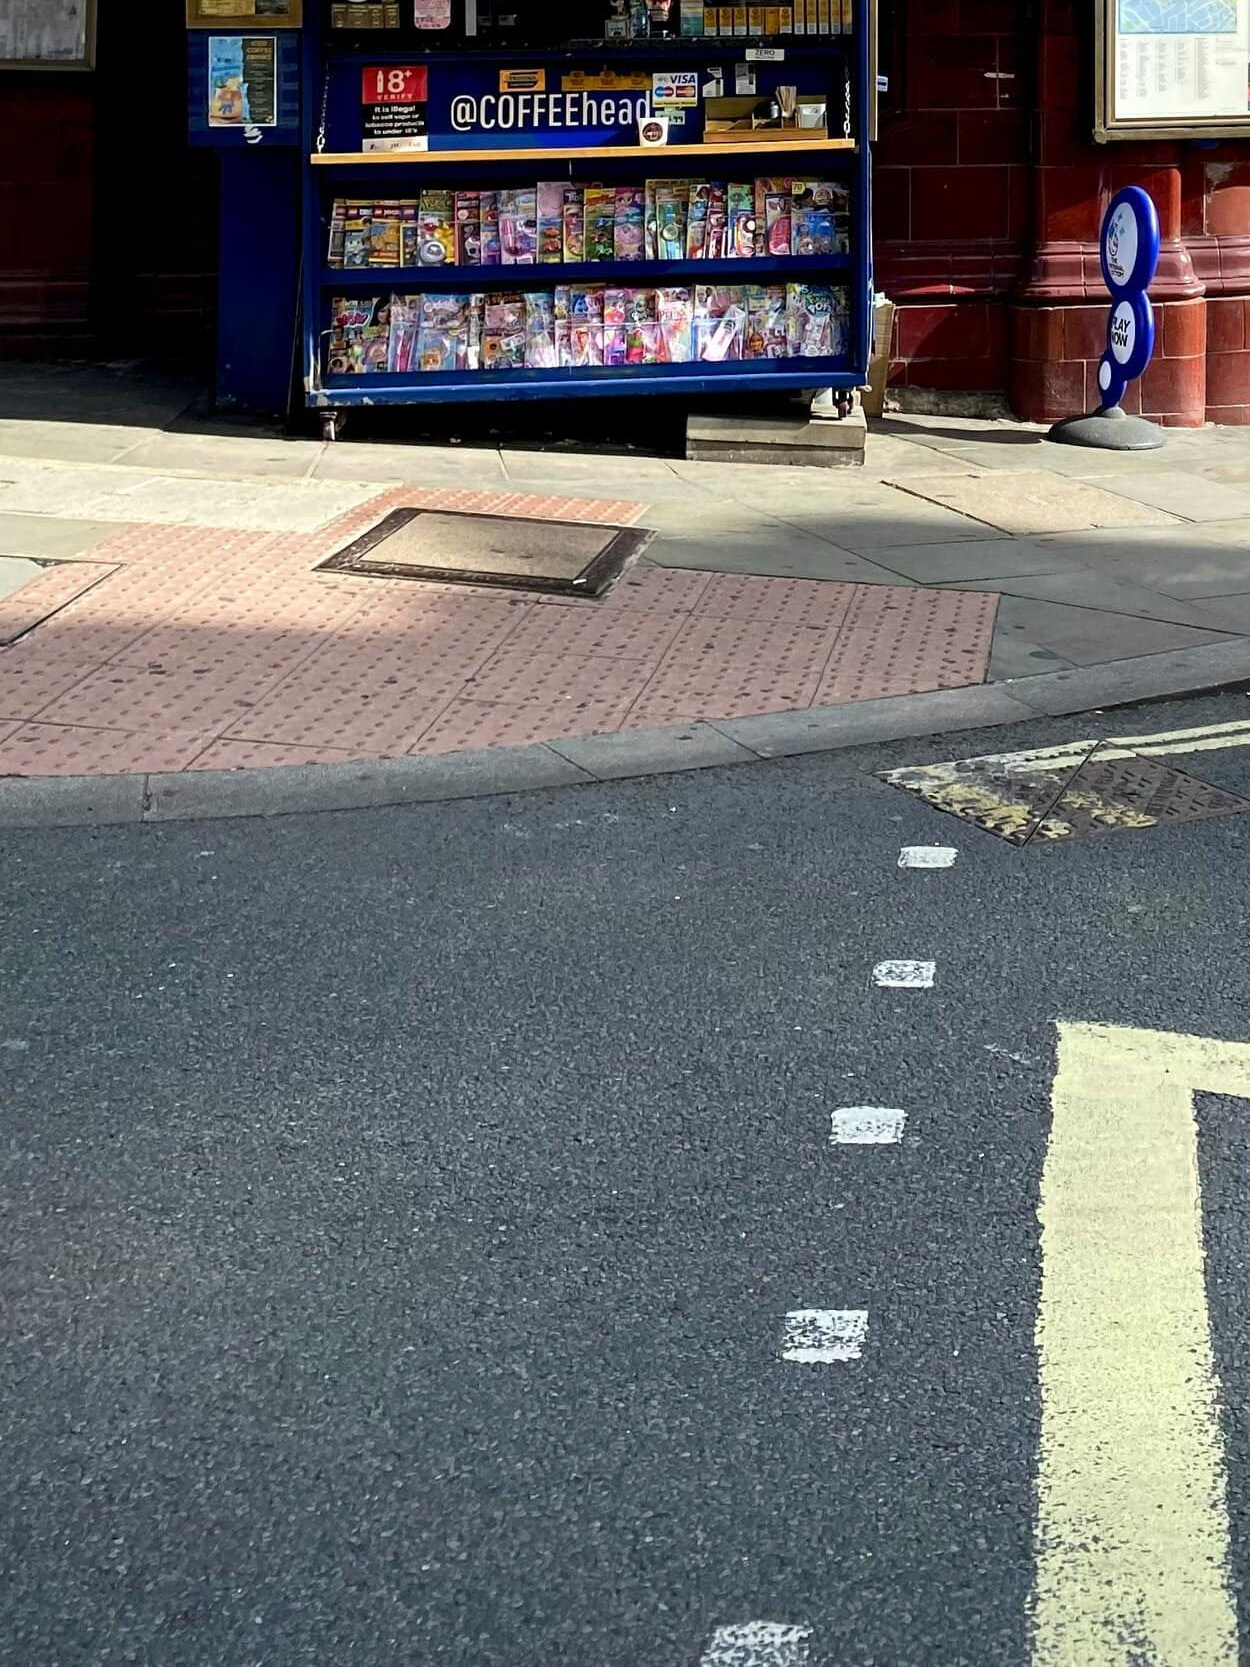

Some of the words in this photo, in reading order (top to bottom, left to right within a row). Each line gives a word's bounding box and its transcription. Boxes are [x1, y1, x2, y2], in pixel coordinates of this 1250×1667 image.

[670, 74, 697, 84] VISA
[376, 93, 413, 101] VERIFY
[390, 105, 416, 114] illegal
[450, 90, 650, 132] @COFFEEhead
[1112, 316, 1131, 333] PLAY
